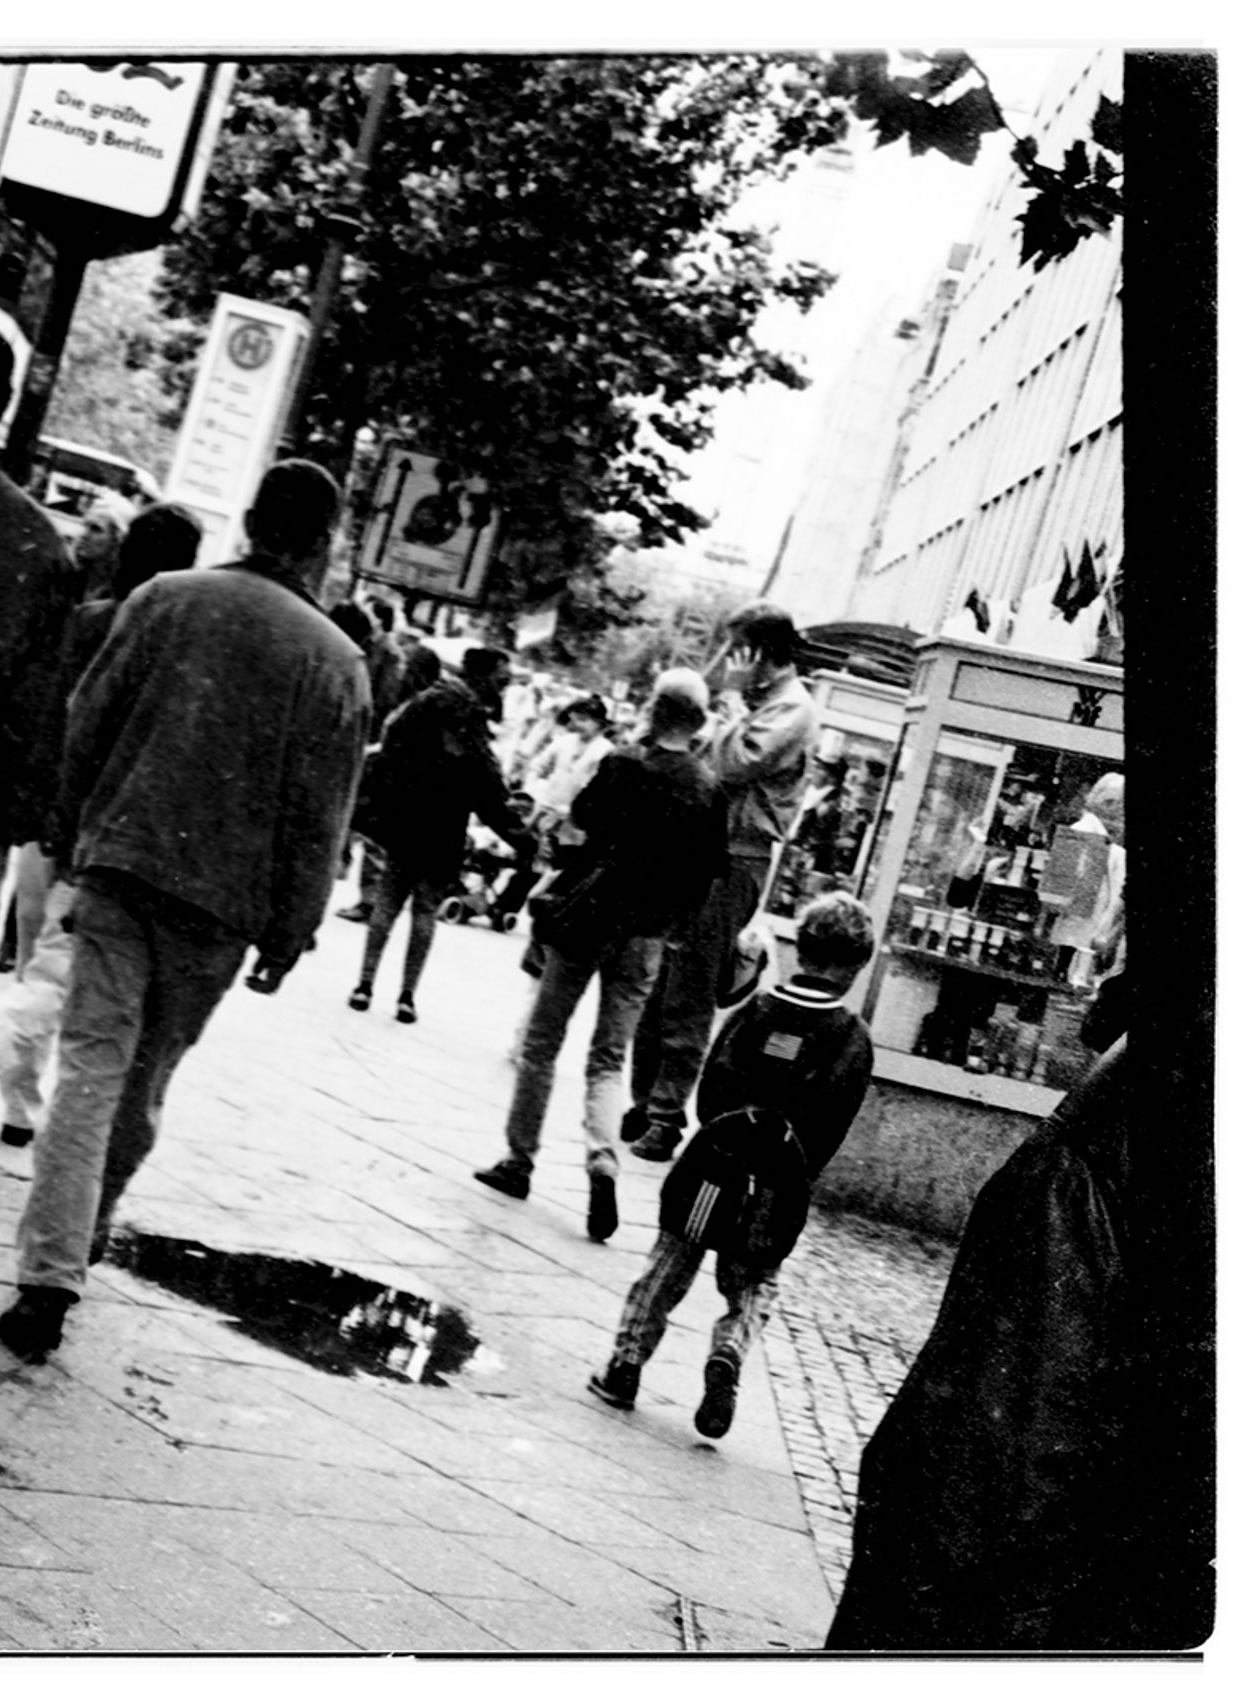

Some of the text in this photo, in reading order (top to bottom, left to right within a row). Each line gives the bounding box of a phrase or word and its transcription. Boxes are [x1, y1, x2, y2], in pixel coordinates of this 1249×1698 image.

[54, 89, 152, 129] Die größte
[27, 109, 165, 160] Zeitung Berlins
